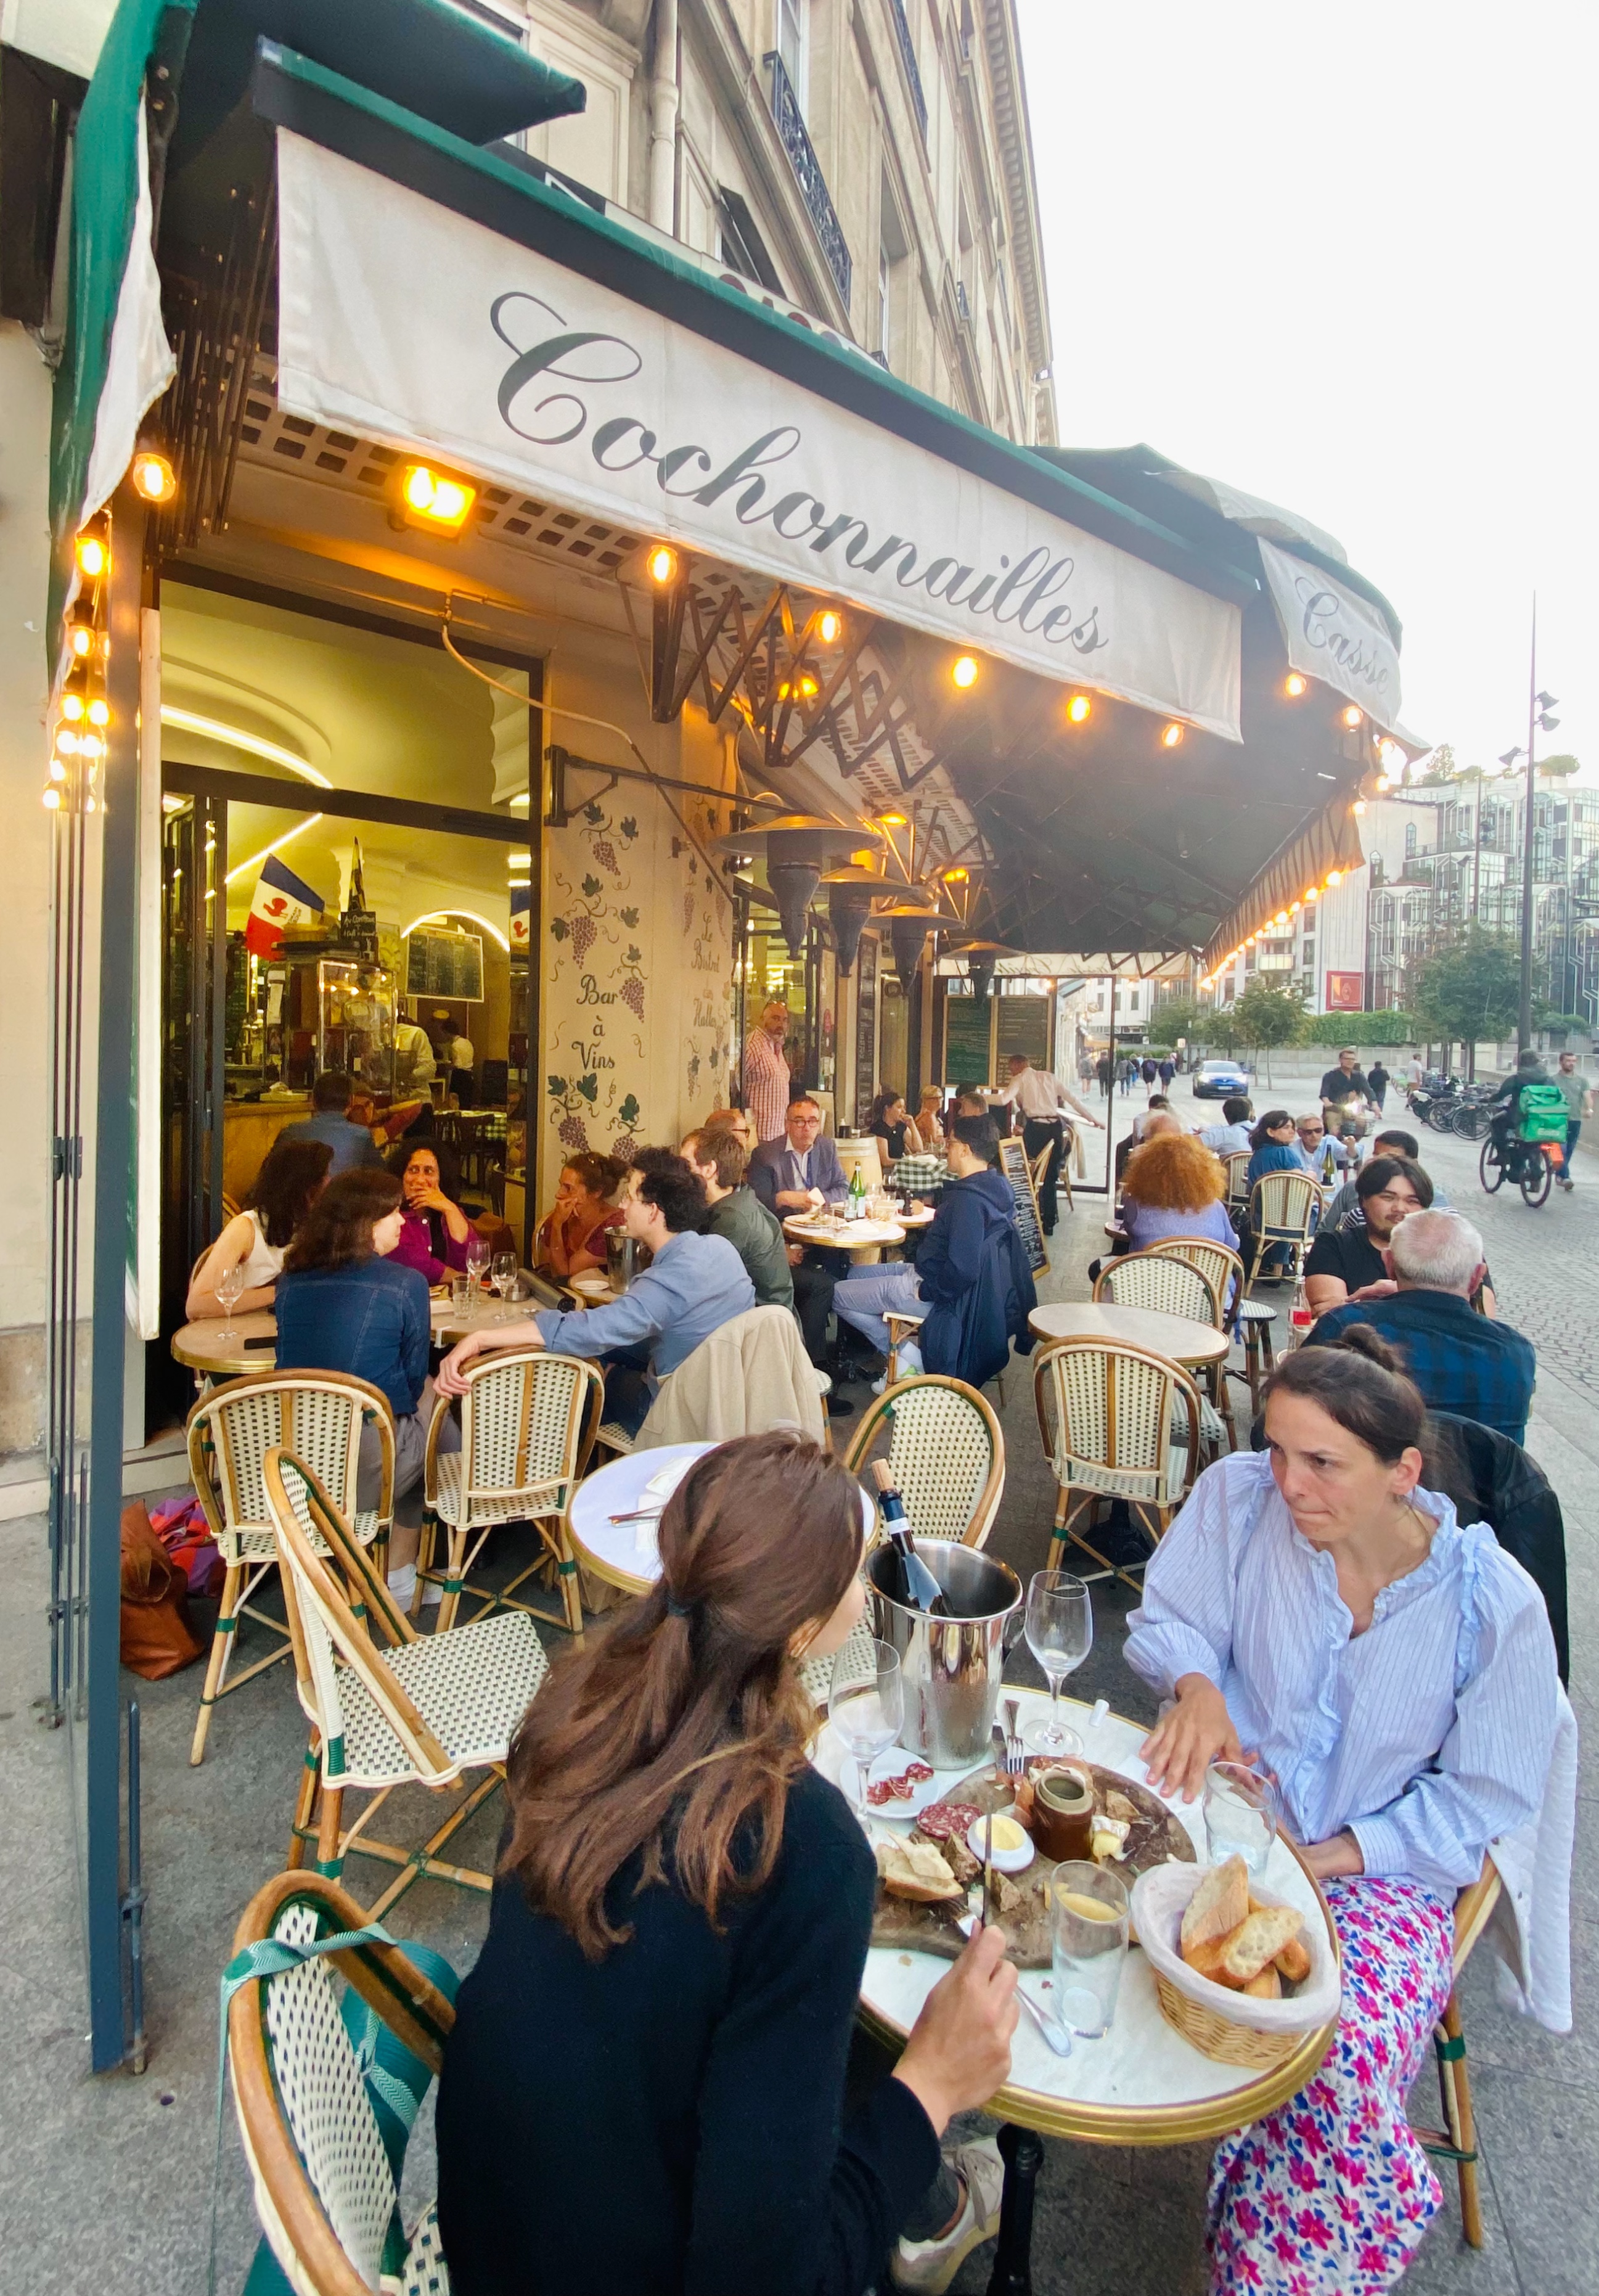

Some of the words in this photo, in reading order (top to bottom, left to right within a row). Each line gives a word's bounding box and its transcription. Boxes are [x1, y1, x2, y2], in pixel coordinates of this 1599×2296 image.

[490, 291, 1109, 655] Cochonnailles
[1294, 576, 1388, 694] Casse
[576, 974, 618, 1005] Bar
[593, 1015, 605, 1036] à
[571, 1040, 615, 1071] Vins
